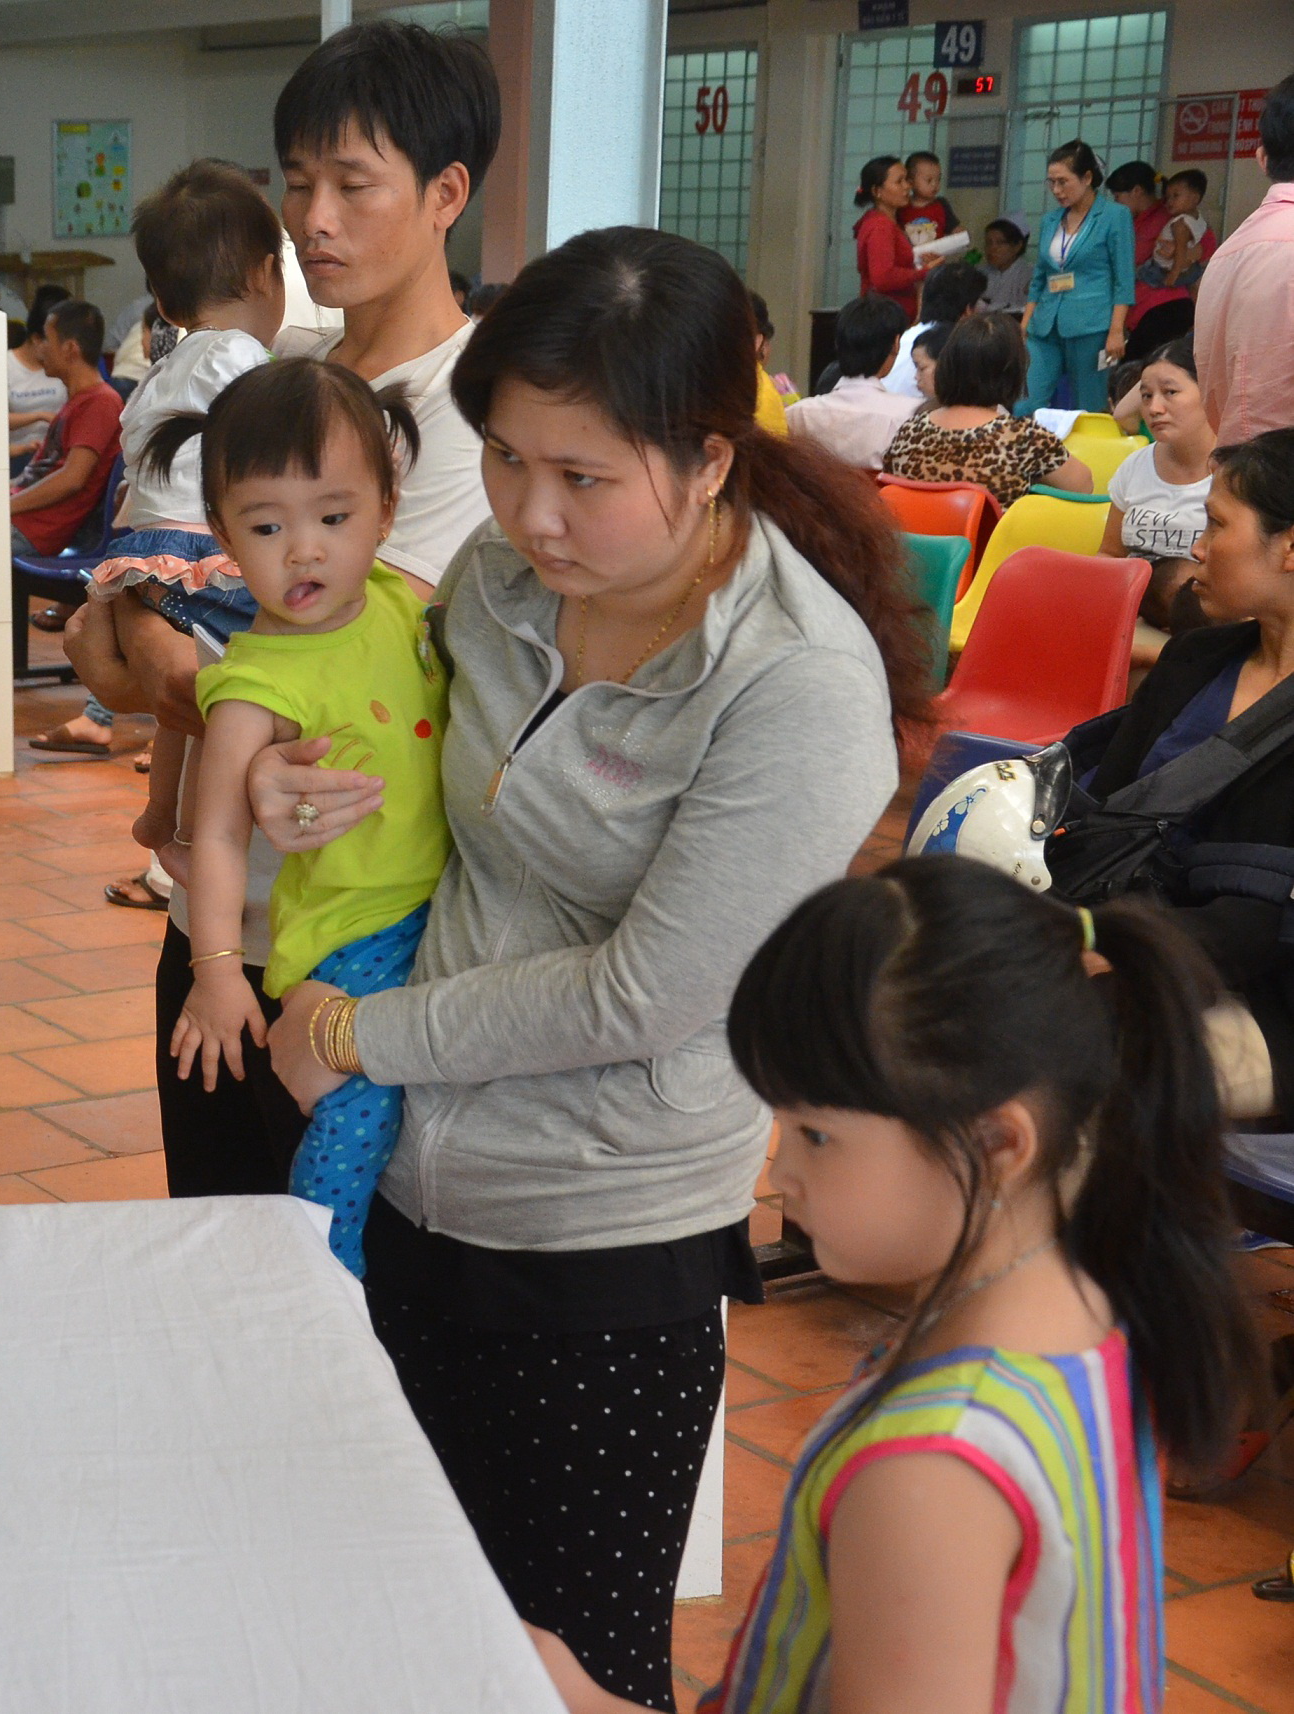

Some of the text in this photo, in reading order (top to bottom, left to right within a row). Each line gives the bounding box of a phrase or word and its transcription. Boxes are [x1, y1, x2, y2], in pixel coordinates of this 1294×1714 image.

[941, 25, 976, 63] 49
[897, 72, 948, 123] 49
[975, 76, 994, 93] 57
[695, 86, 728, 136] 50
[1126, 507, 1180, 527] NEW
